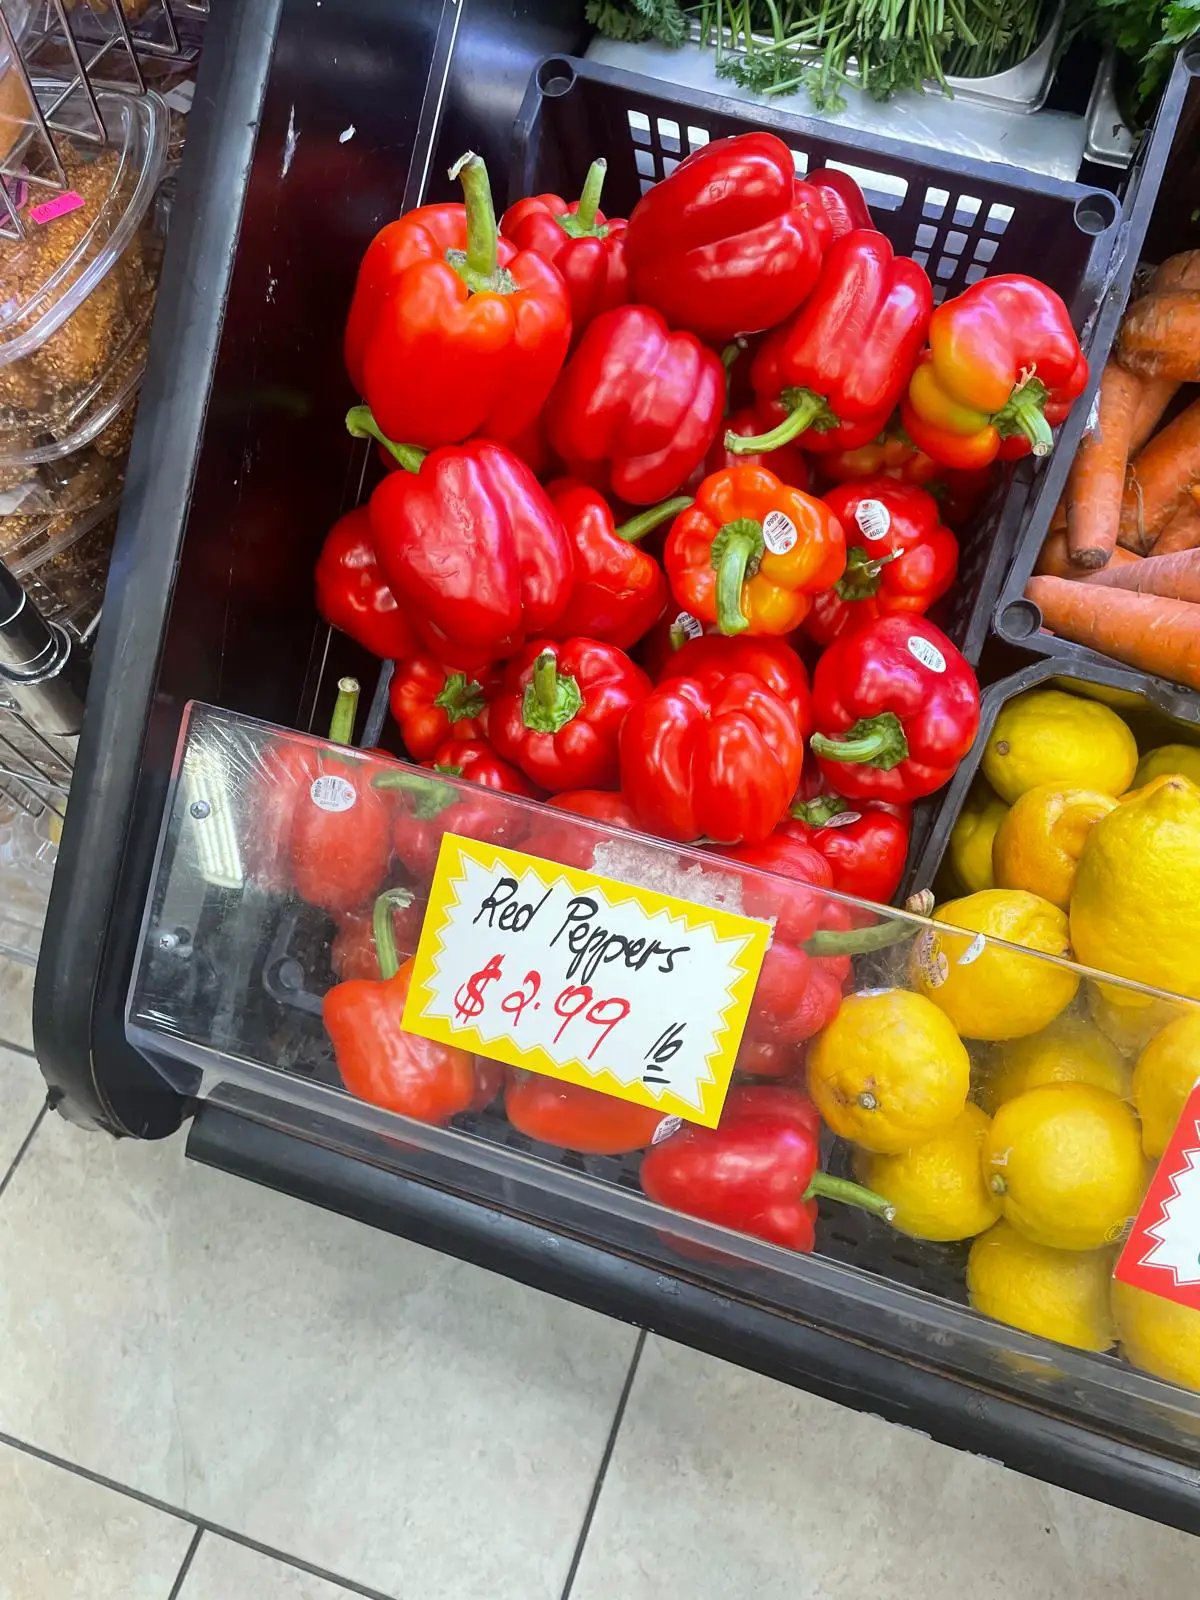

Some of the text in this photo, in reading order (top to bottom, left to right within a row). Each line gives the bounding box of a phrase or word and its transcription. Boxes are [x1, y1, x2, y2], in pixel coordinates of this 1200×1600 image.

[473, 877, 691, 986] Red Peppers
[644, 1022, 688, 1070] lb
